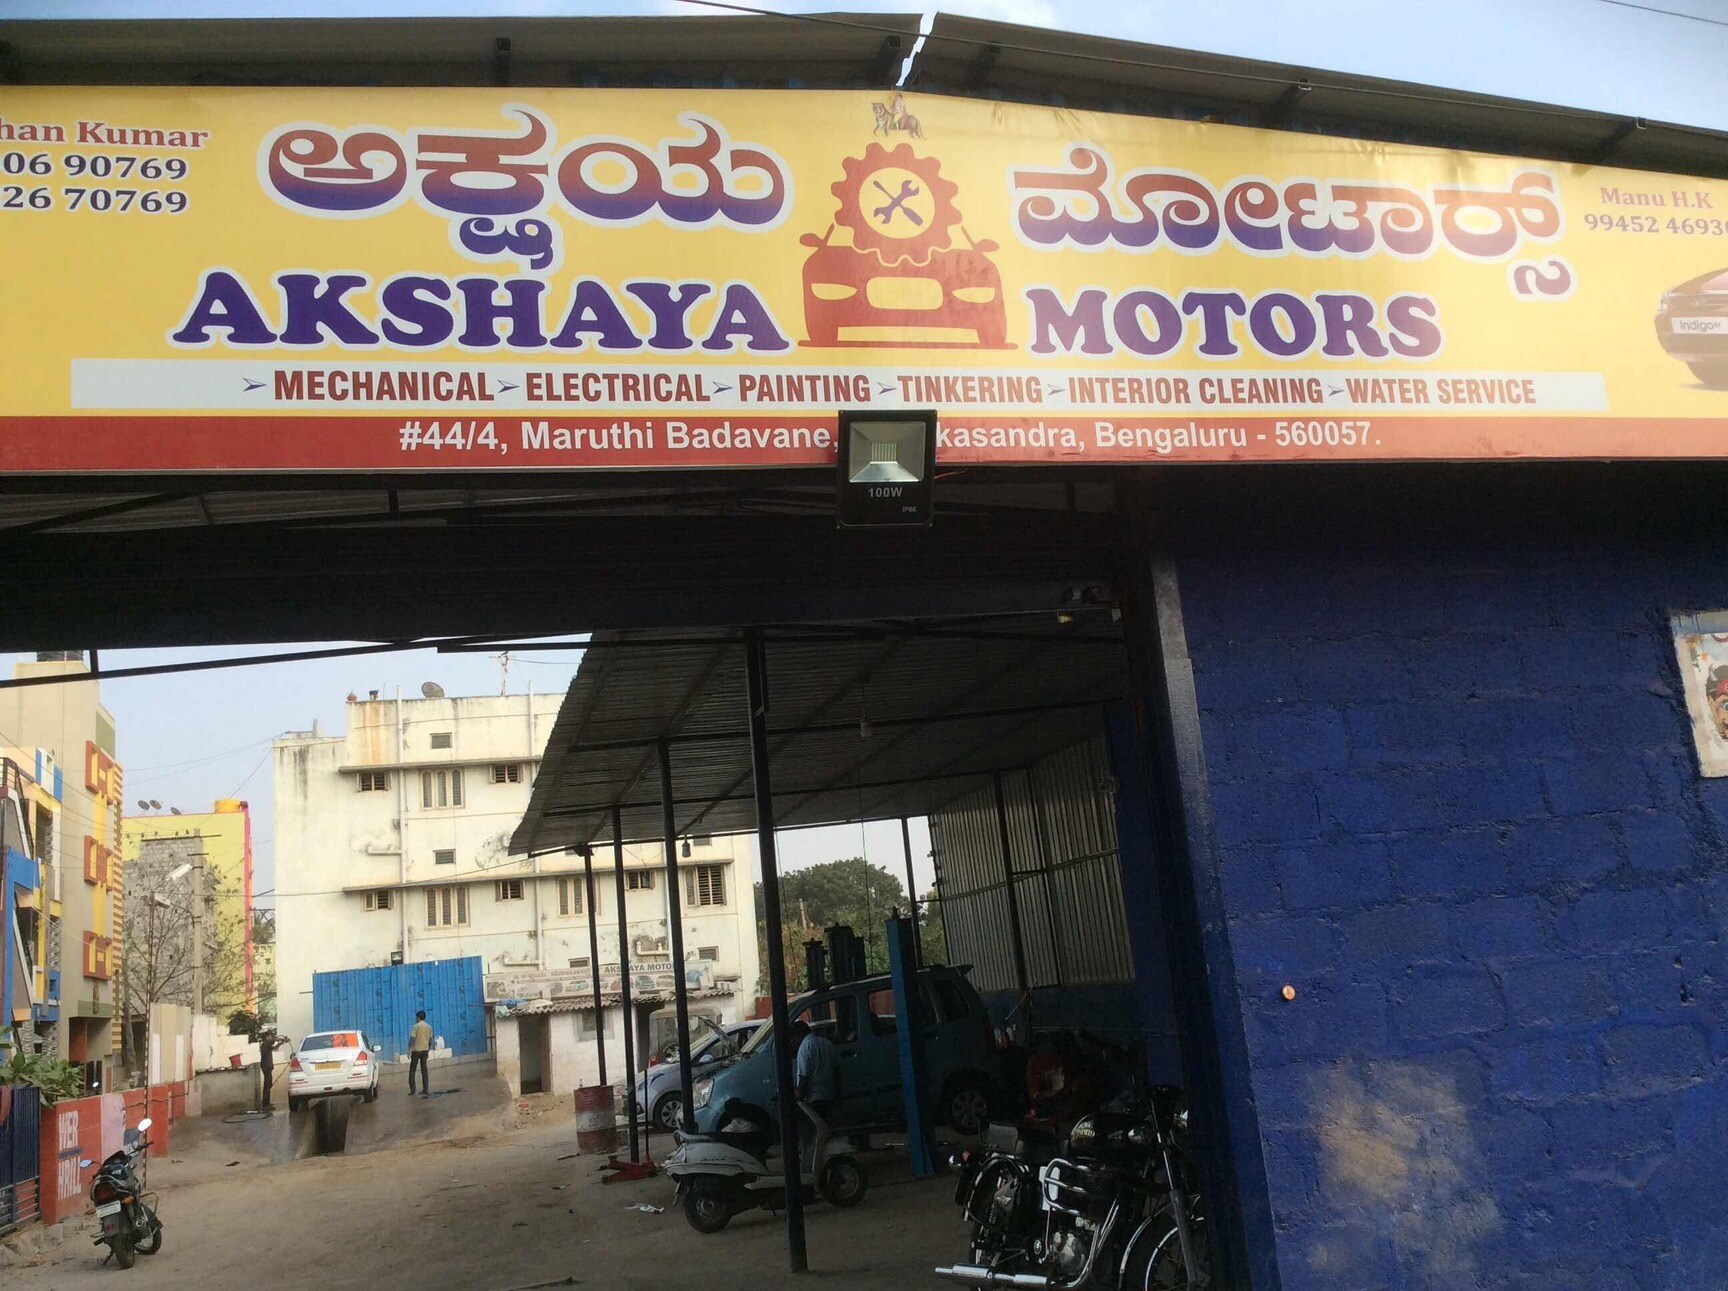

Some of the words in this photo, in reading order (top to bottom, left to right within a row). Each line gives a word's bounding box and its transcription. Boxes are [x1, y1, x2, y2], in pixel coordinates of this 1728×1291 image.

[0, 118, 65, 142] han
[77, 121, 209, 147] Kumar
[3, 152, 52, 175] 06
[64, 155, 187, 179] 90769
[3, 186, 52, 209] 26
[64, 188, 187, 213] 70769
[268, 109, 785, 270] ಅಕ್ಷಯ
[1013, 147, 1571, 296] ಮೋಟಾರ್ಸ್
[1600, 188, 1666, 207] Manu
[1671, 191, 1713, 209] H.K
[1584, 213, 1659, 233] 99452
[1666, 217, 1728, 236] 4693
[172, 271, 790, 351] AKSHAYA
[1025, 288, 1442, 359] MOTORS
[274, 370, 494, 401] MECHANICAL
[526, 372, 710, 403] ELECTRICAL
[739, 374, 871, 403] PAINTING
[897, 375, 1042, 404] TINKERING
[1069, 377, 1190, 404] INTERIOR
[1199, 377, 1323, 405] CLEANING
[1345, 378, 1431, 404] WATER
[1437, 379, 1536, 405] SERVICE
[399, 421, 508, 454] #44/4,
[522, 420, 653, 450] Maruthi
[667, 420, 838, 453] Badavane,
[936, 421, 1085, 452] kasandra,
[1095, 422, 1247, 454] Bengaluru
[1275, 421, 1381, 447] 560057.
[868, 487, 903, 498] 100W
[604, 963, 645, 975] AKSAYA
[647, 962, 673, 972] MOTO
